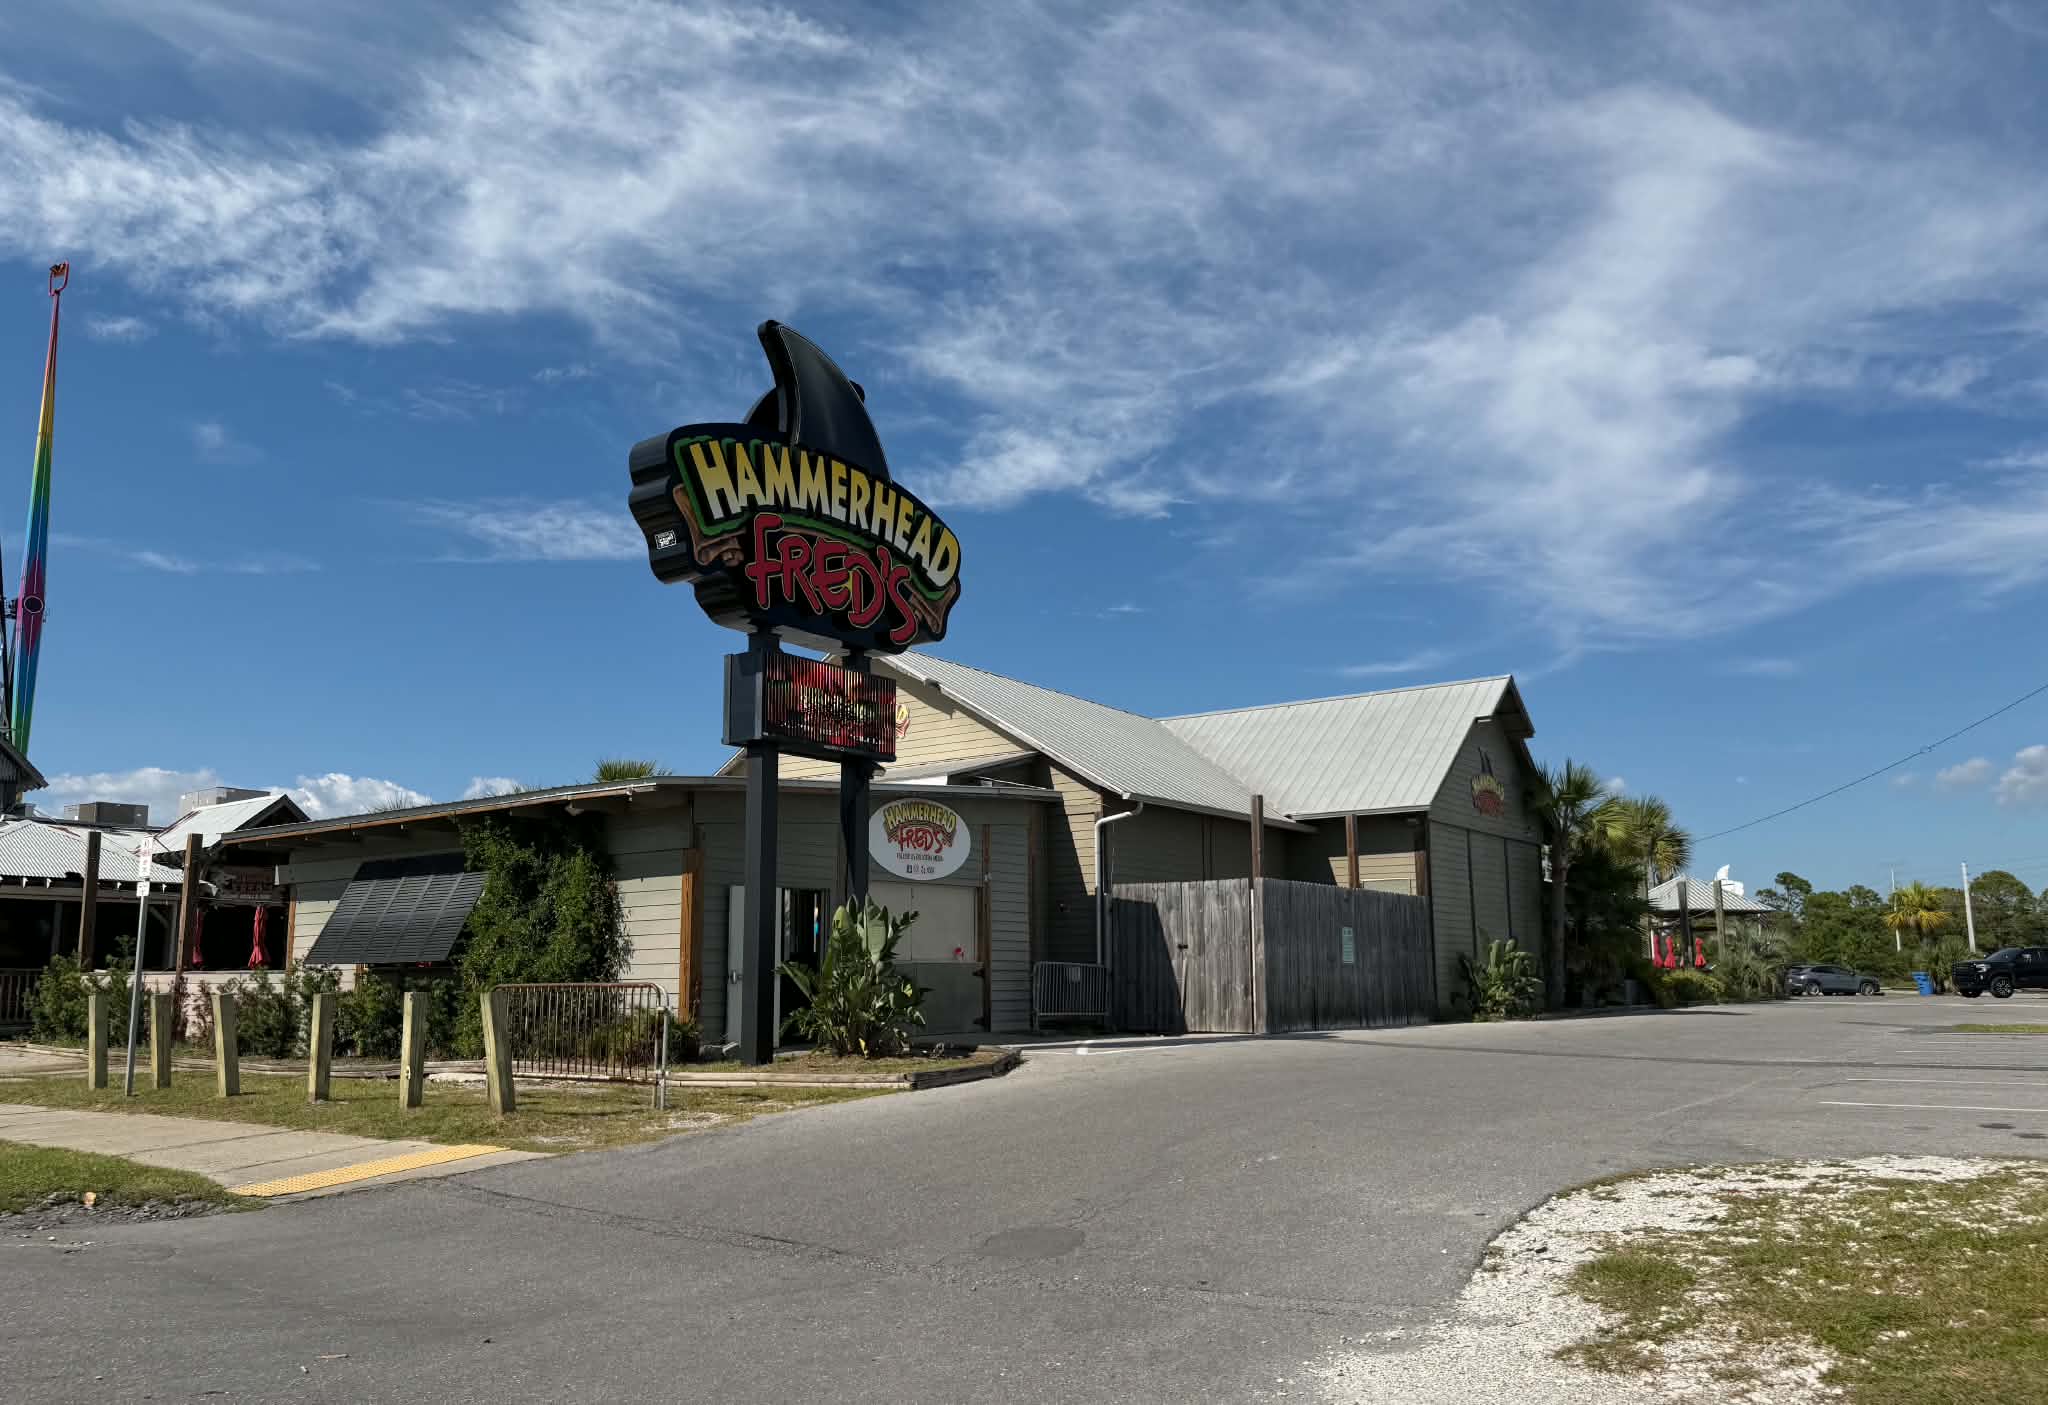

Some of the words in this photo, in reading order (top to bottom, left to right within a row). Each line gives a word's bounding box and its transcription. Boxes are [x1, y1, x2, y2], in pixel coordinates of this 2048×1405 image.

[689, 440, 960, 588] HAMMERHEAD
[745, 512, 918, 645] FRED'S
[884, 802, 957, 833] HAMMERHEAD
